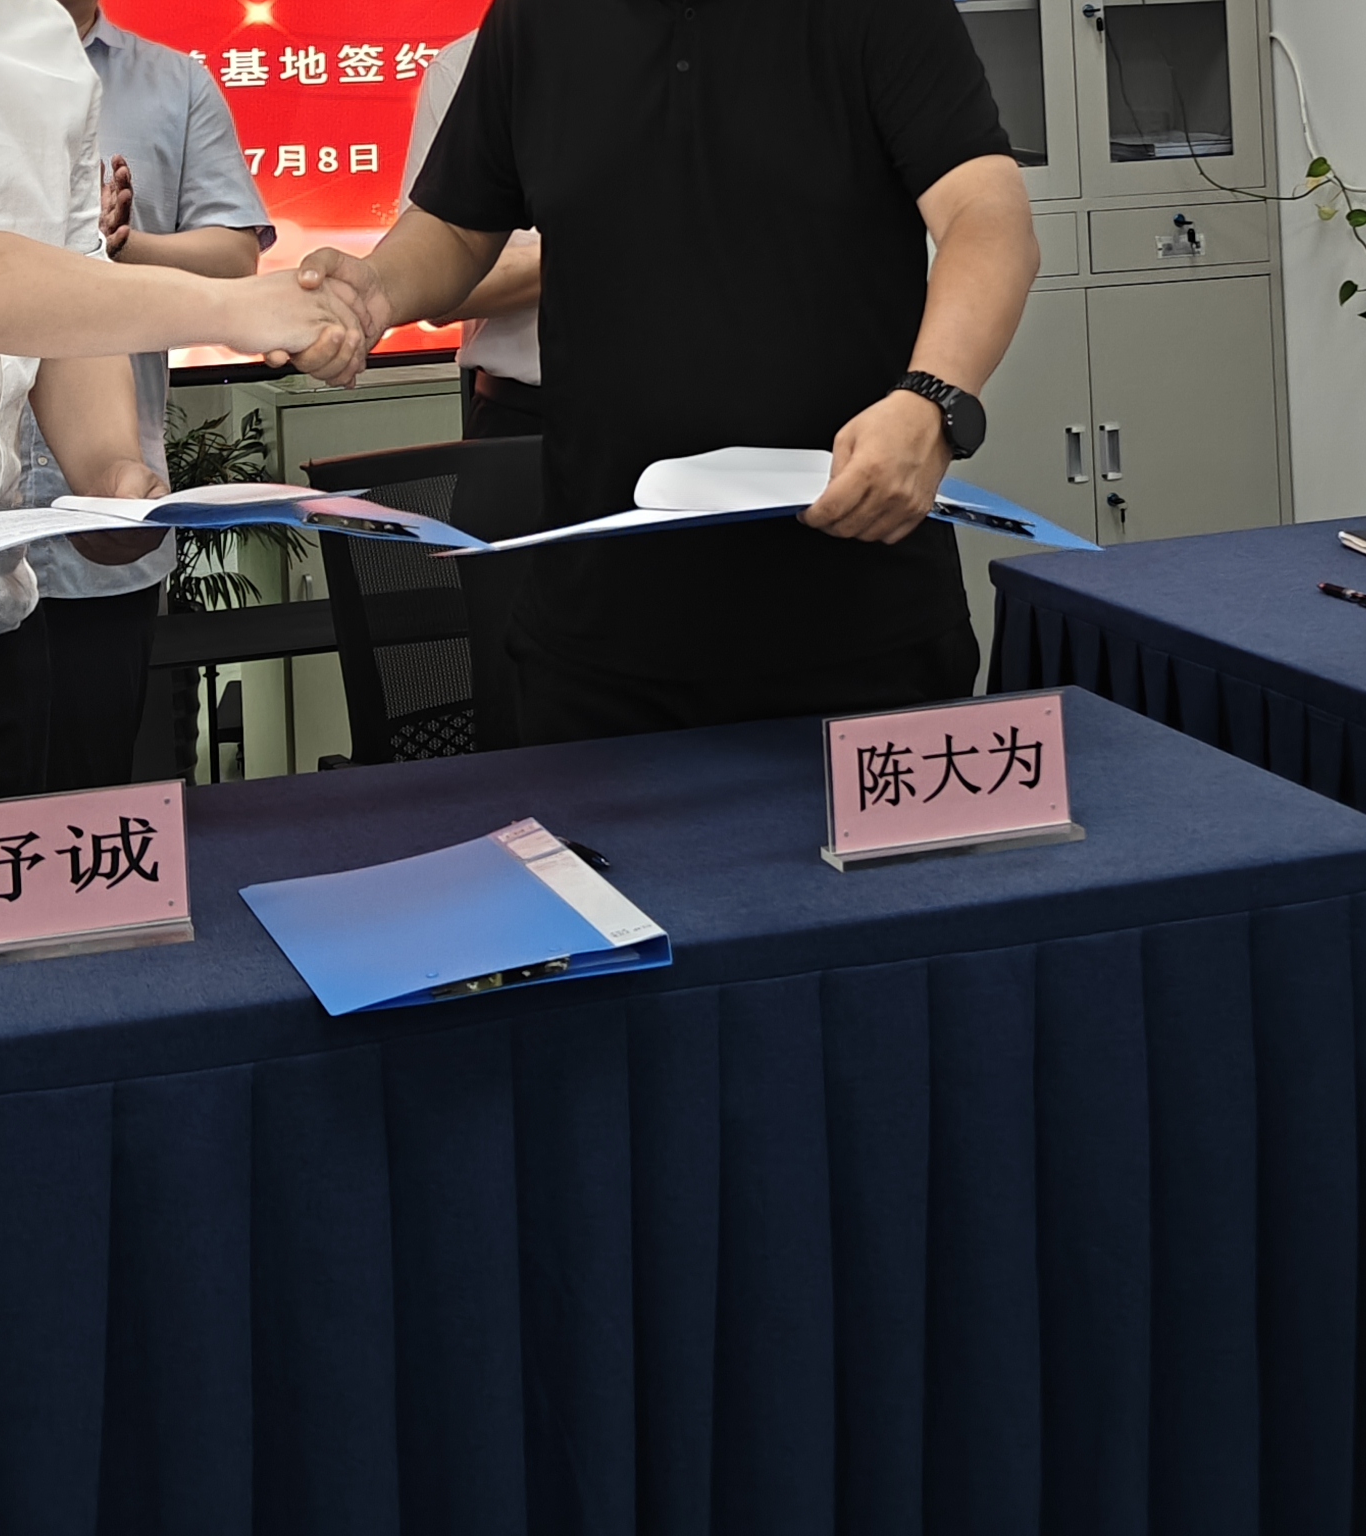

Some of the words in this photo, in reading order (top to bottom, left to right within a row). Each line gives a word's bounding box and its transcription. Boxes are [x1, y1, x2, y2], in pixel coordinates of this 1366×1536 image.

[188, 42, 439, 89] 基地签约
[243, 143, 379, 178] 7月8日
[856, 724, 1044, 813] 陈大为
